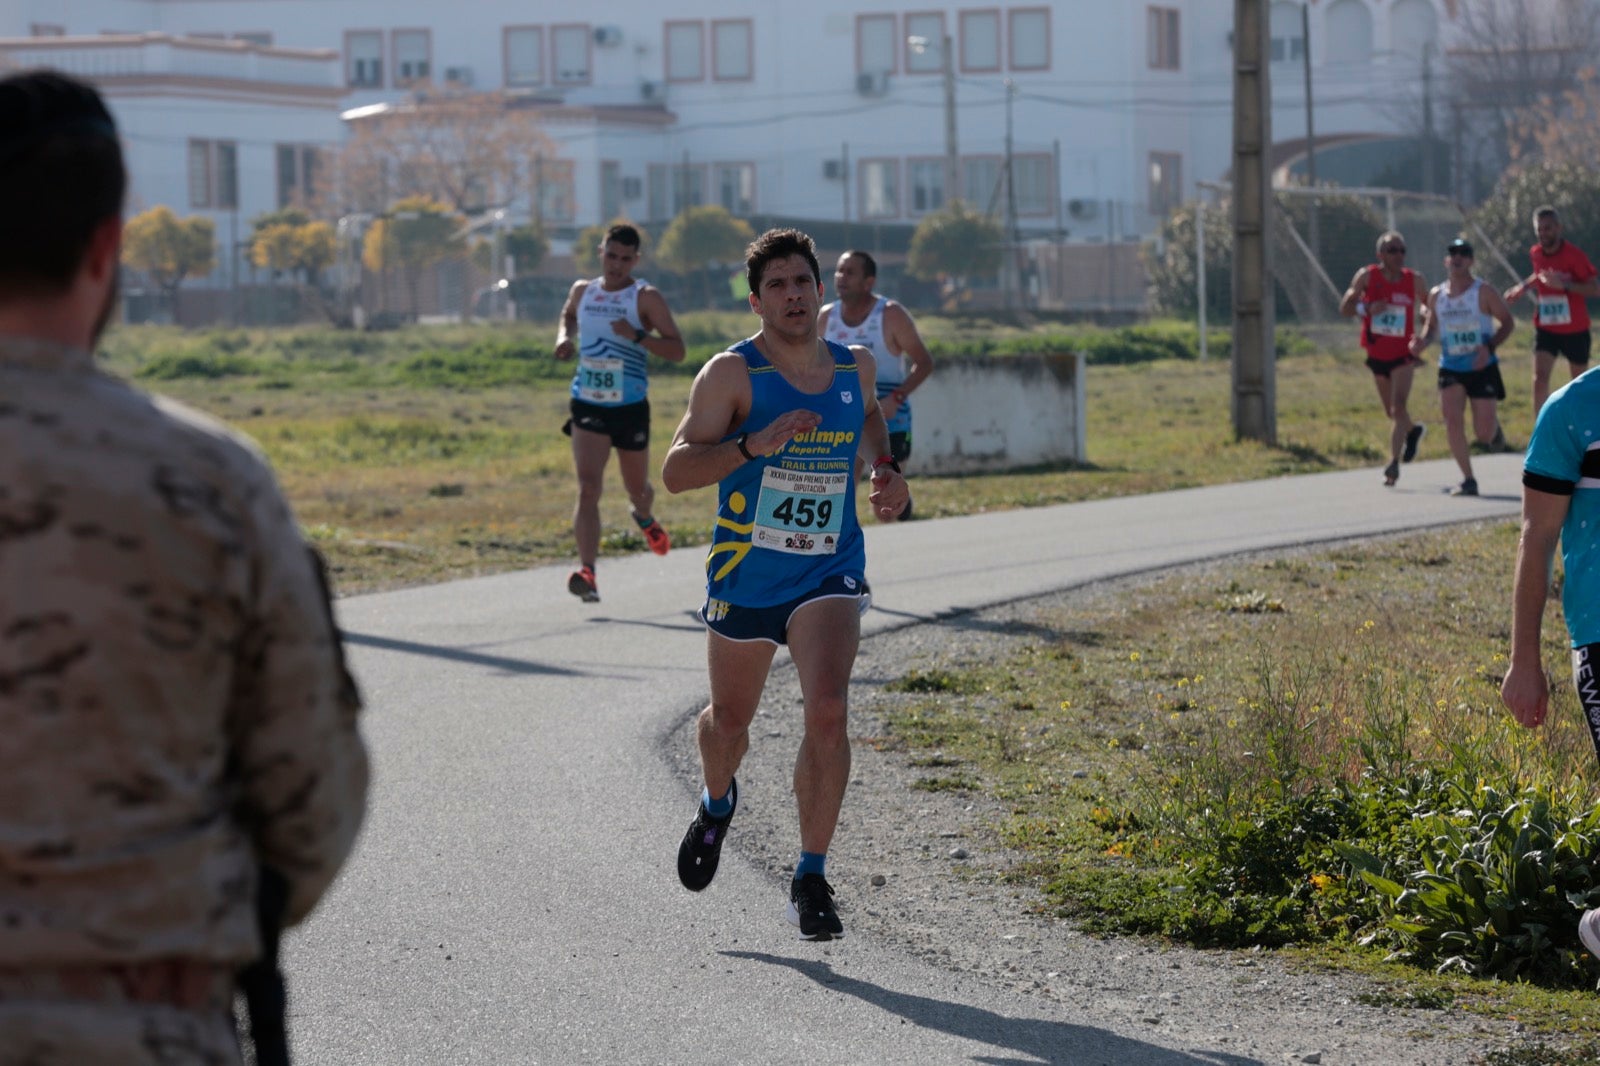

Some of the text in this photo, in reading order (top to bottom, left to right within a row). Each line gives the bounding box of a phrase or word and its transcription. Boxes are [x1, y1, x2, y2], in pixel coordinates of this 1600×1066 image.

[586, 370, 614, 388] 758
[788, 445, 831, 455] deportes
[781, 460, 849, 471] TRAIL & RUNNING
[787, 472, 803, 483] GRAN
[803, 474, 824, 484] PREMIO
[824, 476, 831, 485] DE
[772, 496, 832, 528] 459
